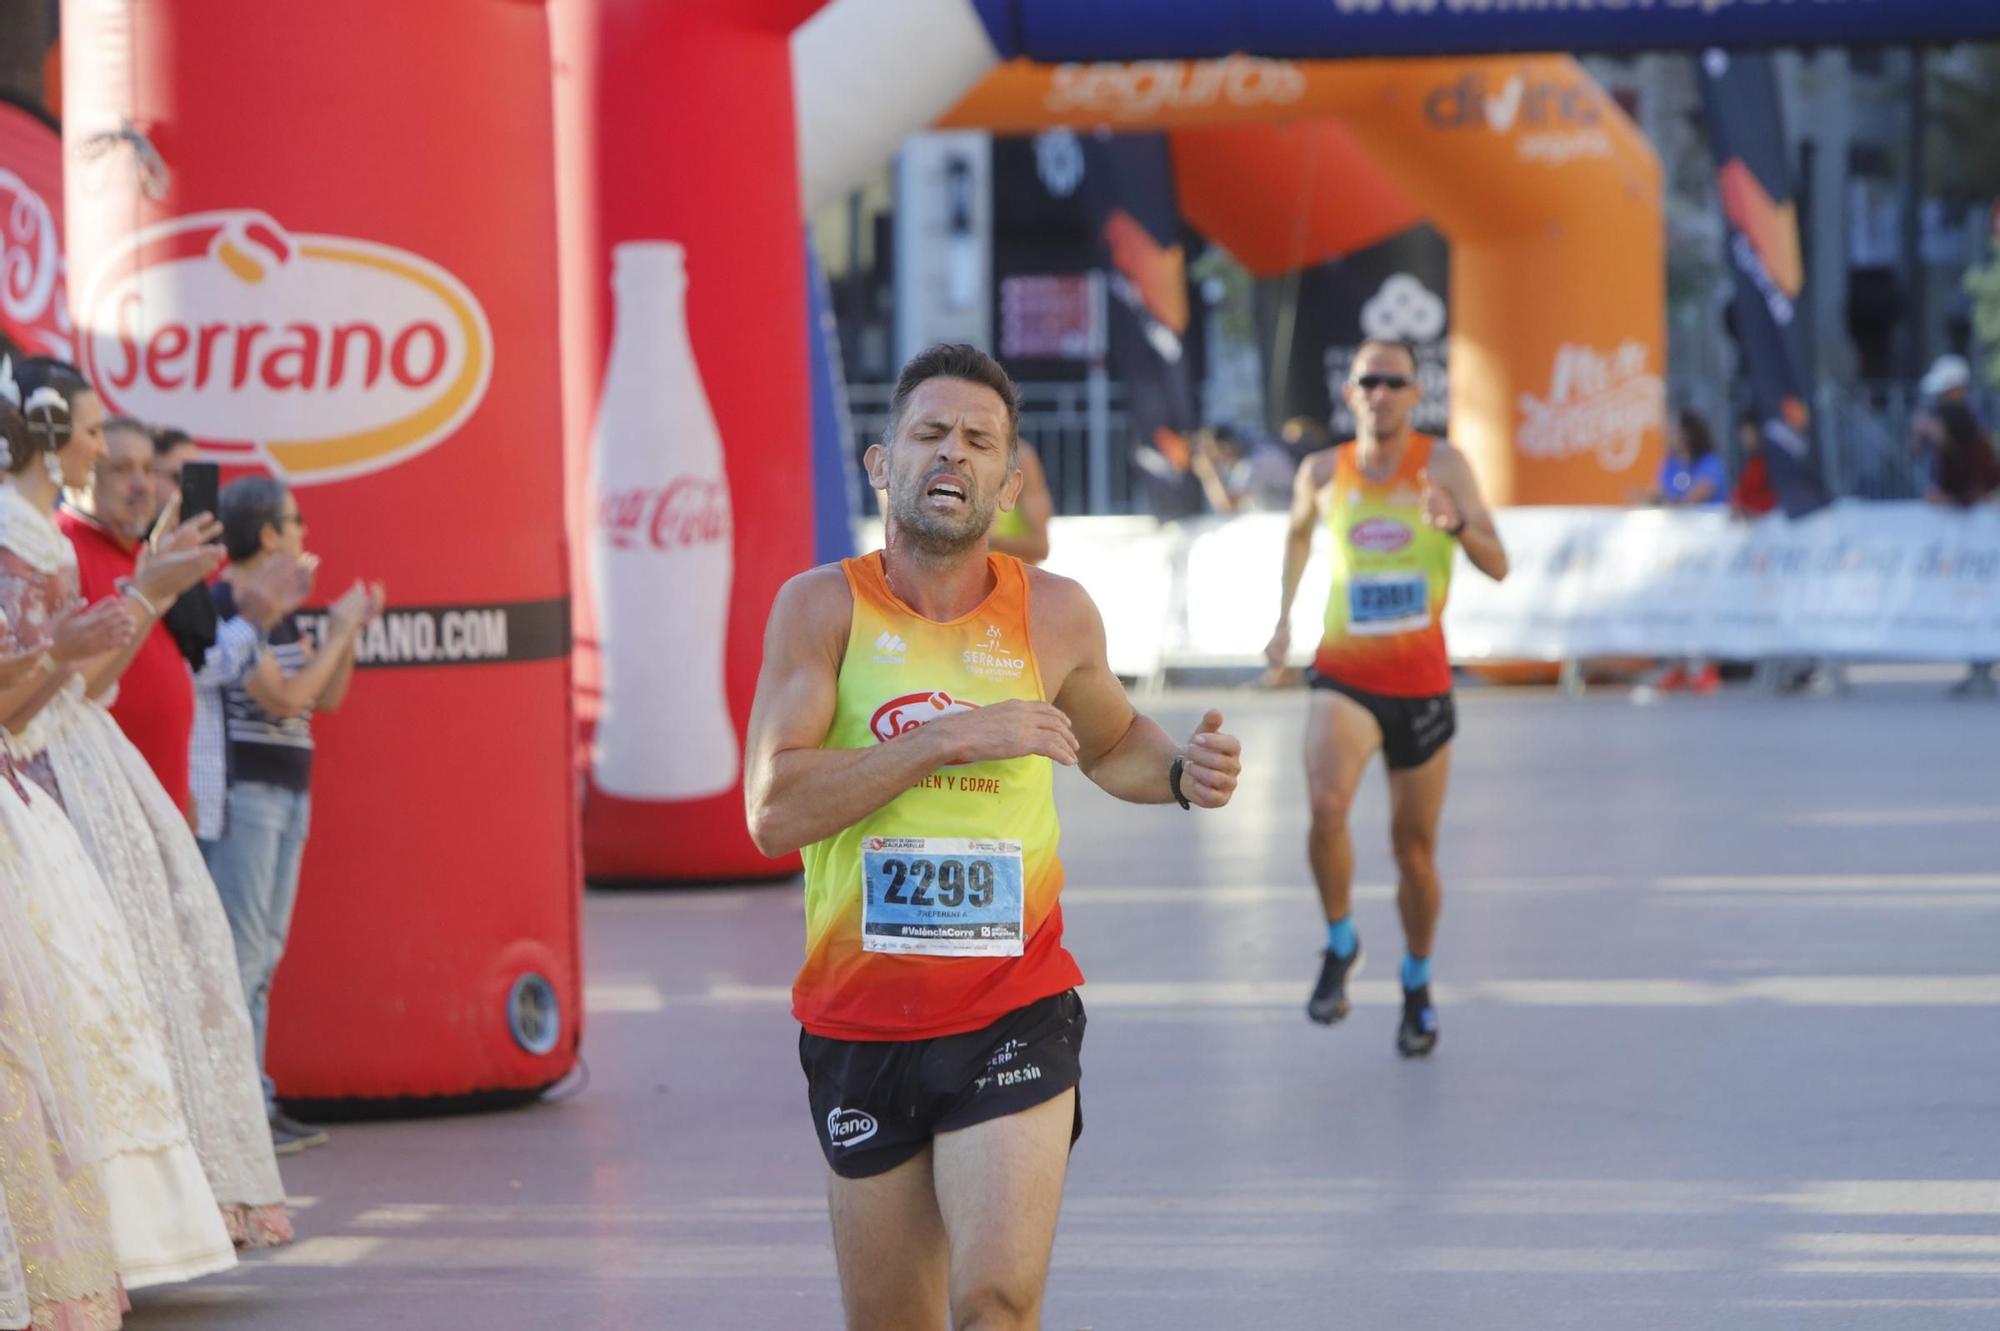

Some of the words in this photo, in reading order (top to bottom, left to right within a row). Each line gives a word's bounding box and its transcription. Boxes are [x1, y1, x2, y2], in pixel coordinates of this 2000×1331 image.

[107, 291, 448, 391] Serrano
[962, 650, 1025, 670] SERRANO
[947, 776, 956, 791] Y
[960, 776, 1001, 794] CORRE
[882, 859, 994, 908] 2299
